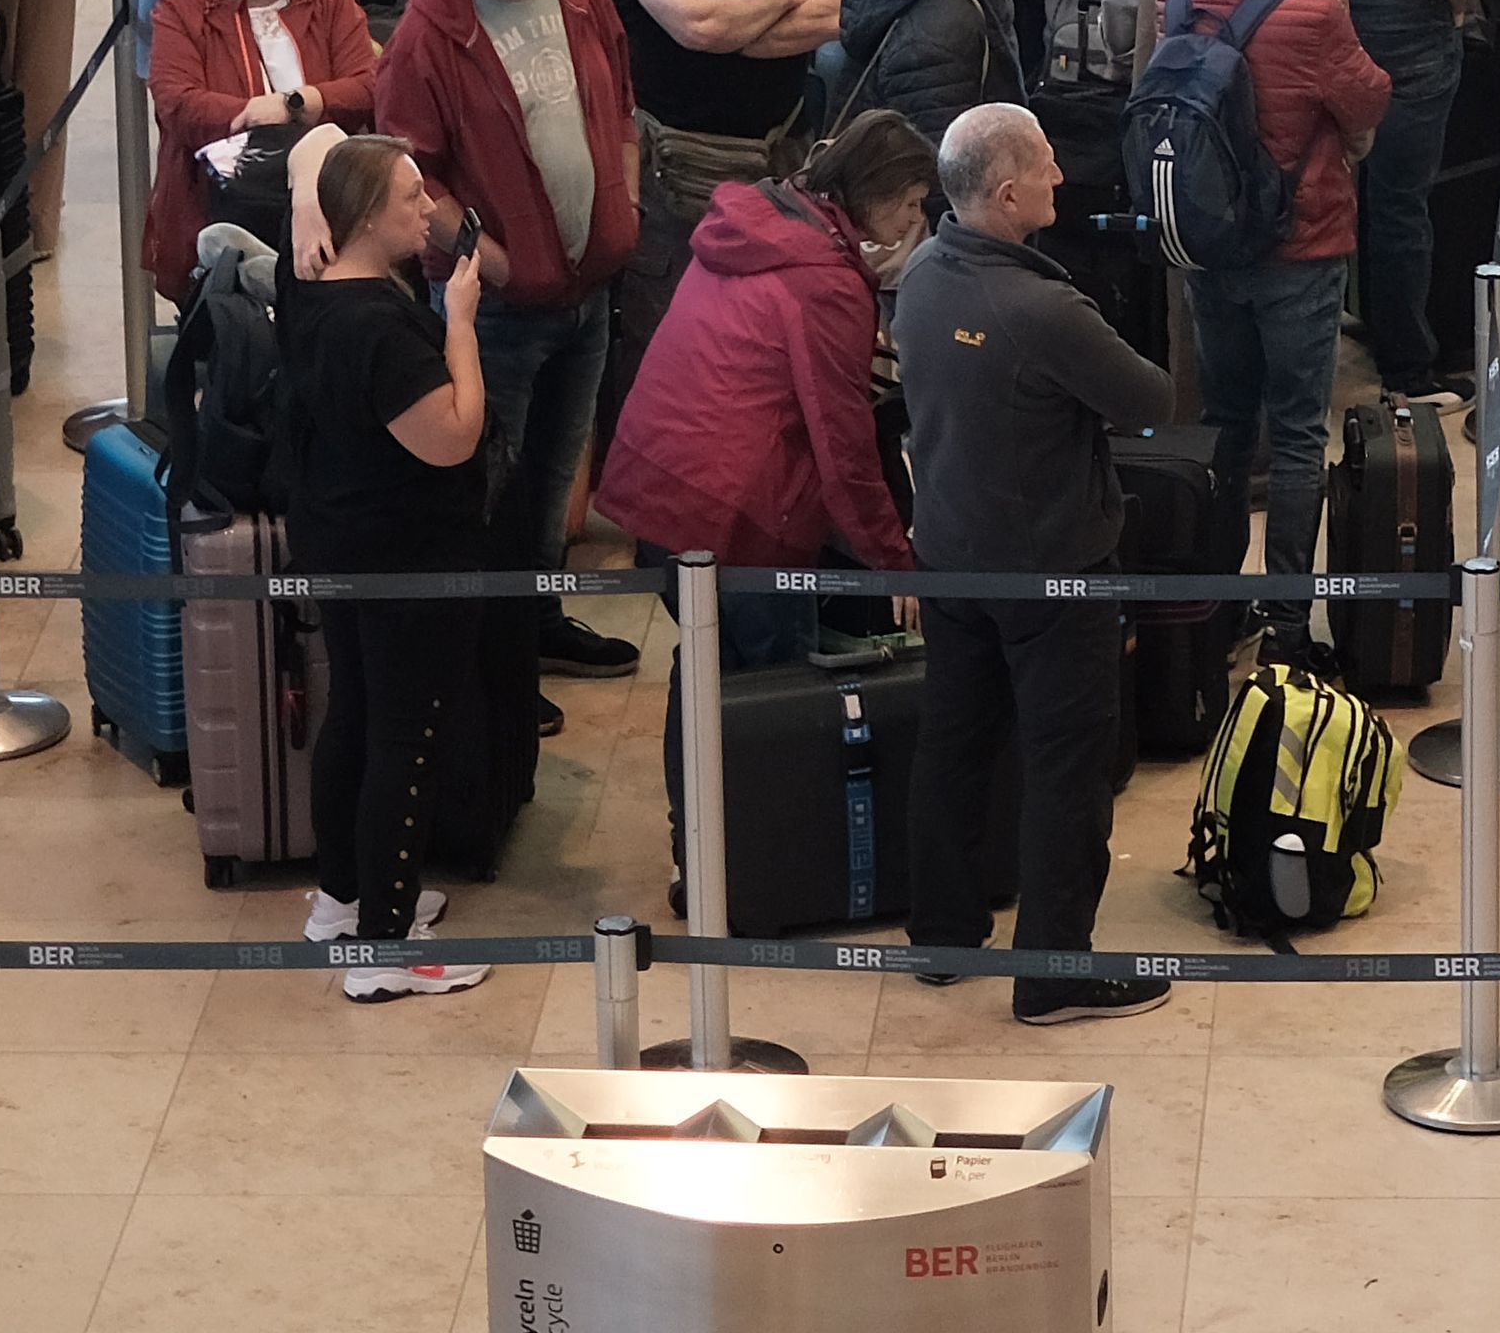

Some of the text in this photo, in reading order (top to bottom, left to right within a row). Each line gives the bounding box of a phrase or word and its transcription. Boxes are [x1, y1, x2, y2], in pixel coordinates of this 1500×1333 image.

[0, 576, 40, 595] BER
[269, 579, 308, 595] BER
[537, 574, 576, 591] BER
[777, 573, 816, 590] BER
[1046, 580, 1086, 596] BER
[1315, 578, 1355, 595] BER
[29, 947, 73, 964] BER
[329, 945, 374, 963] BER
[836, 947, 881, 967] BER
[1137, 957, 1180, 976] BER
[1434, 958, 1480, 976] BER
[956, 1155, 992, 1167] Papier
[986, 1239, 1043, 1251] FLUGHAFEN
[905, 1245, 979, 1278] BER
[986, 1253, 1021, 1263] BERLIN
[986, 1260, 1059, 1274] BRANDENBURG
